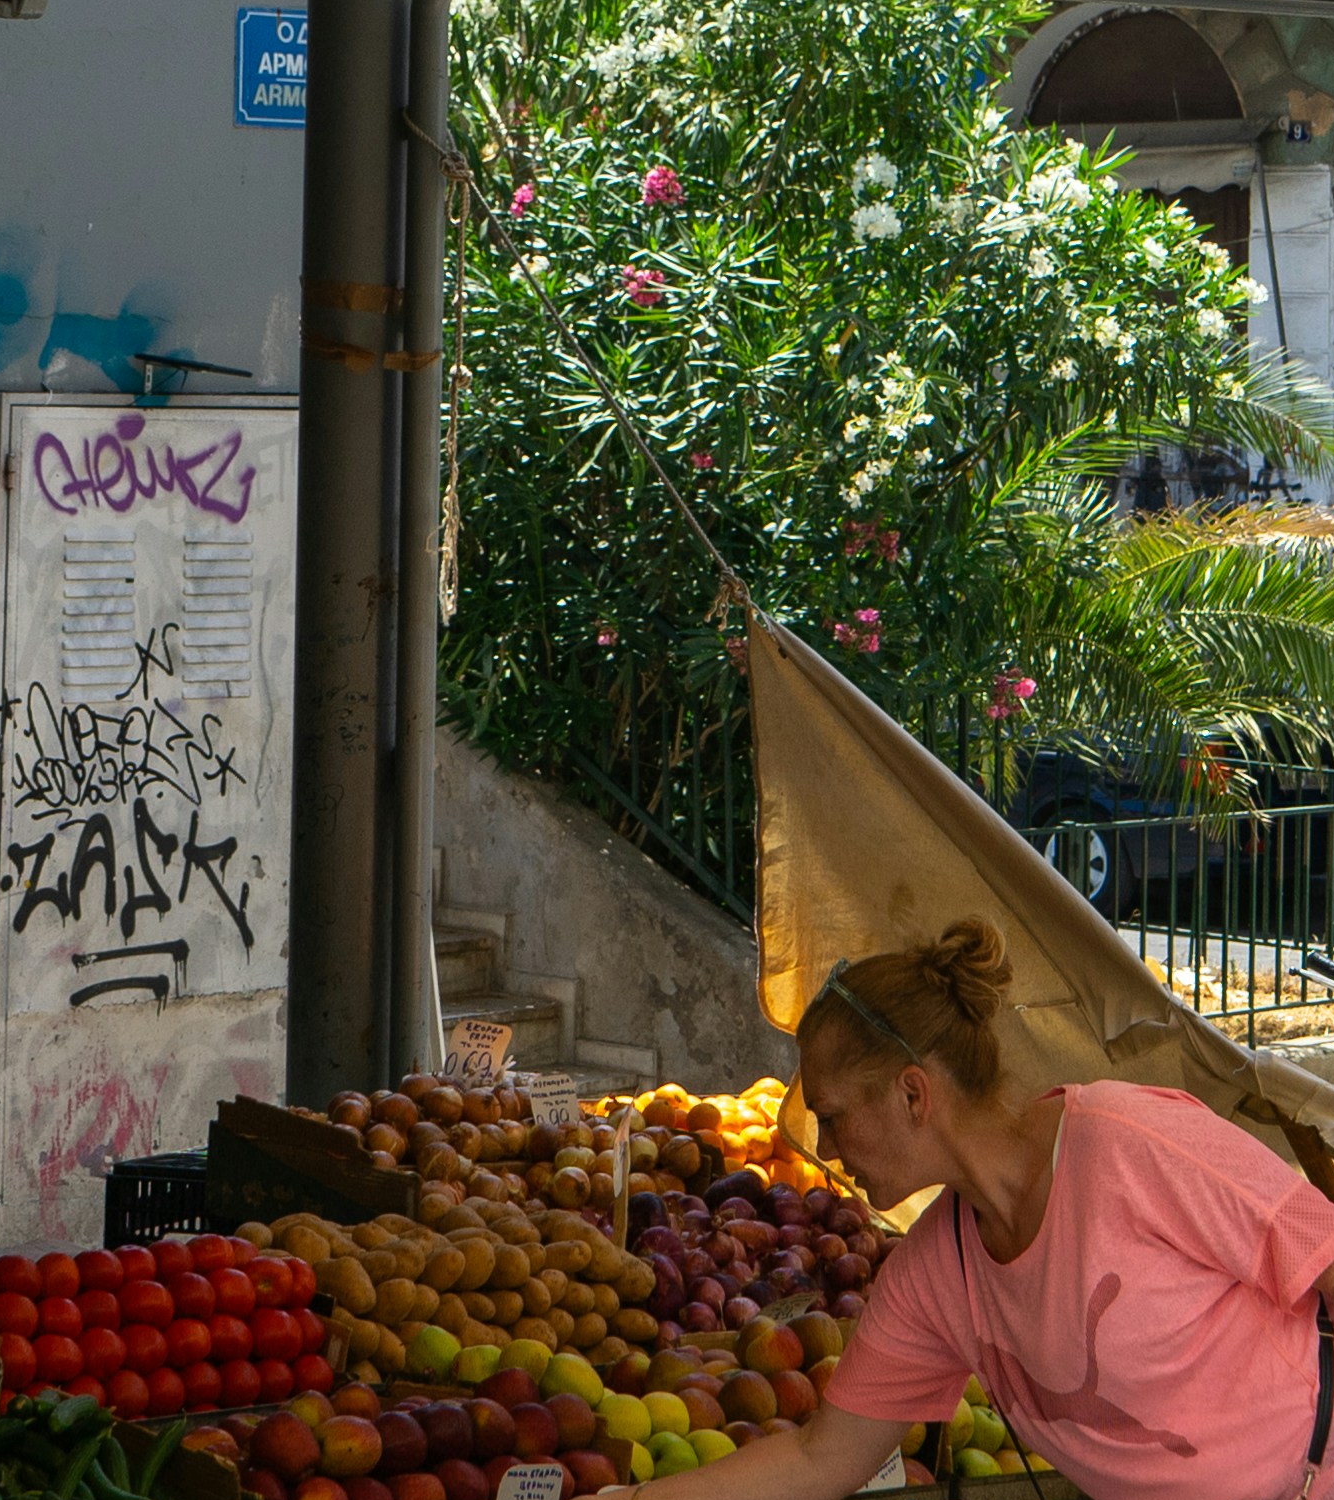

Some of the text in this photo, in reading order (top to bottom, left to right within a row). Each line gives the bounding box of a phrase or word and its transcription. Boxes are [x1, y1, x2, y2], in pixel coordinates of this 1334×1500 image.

[258, 52, 307, 76] ΑΡΜ
[253, 83, 306, 107] ARM
[1294, 123, 1302, 139] 9
